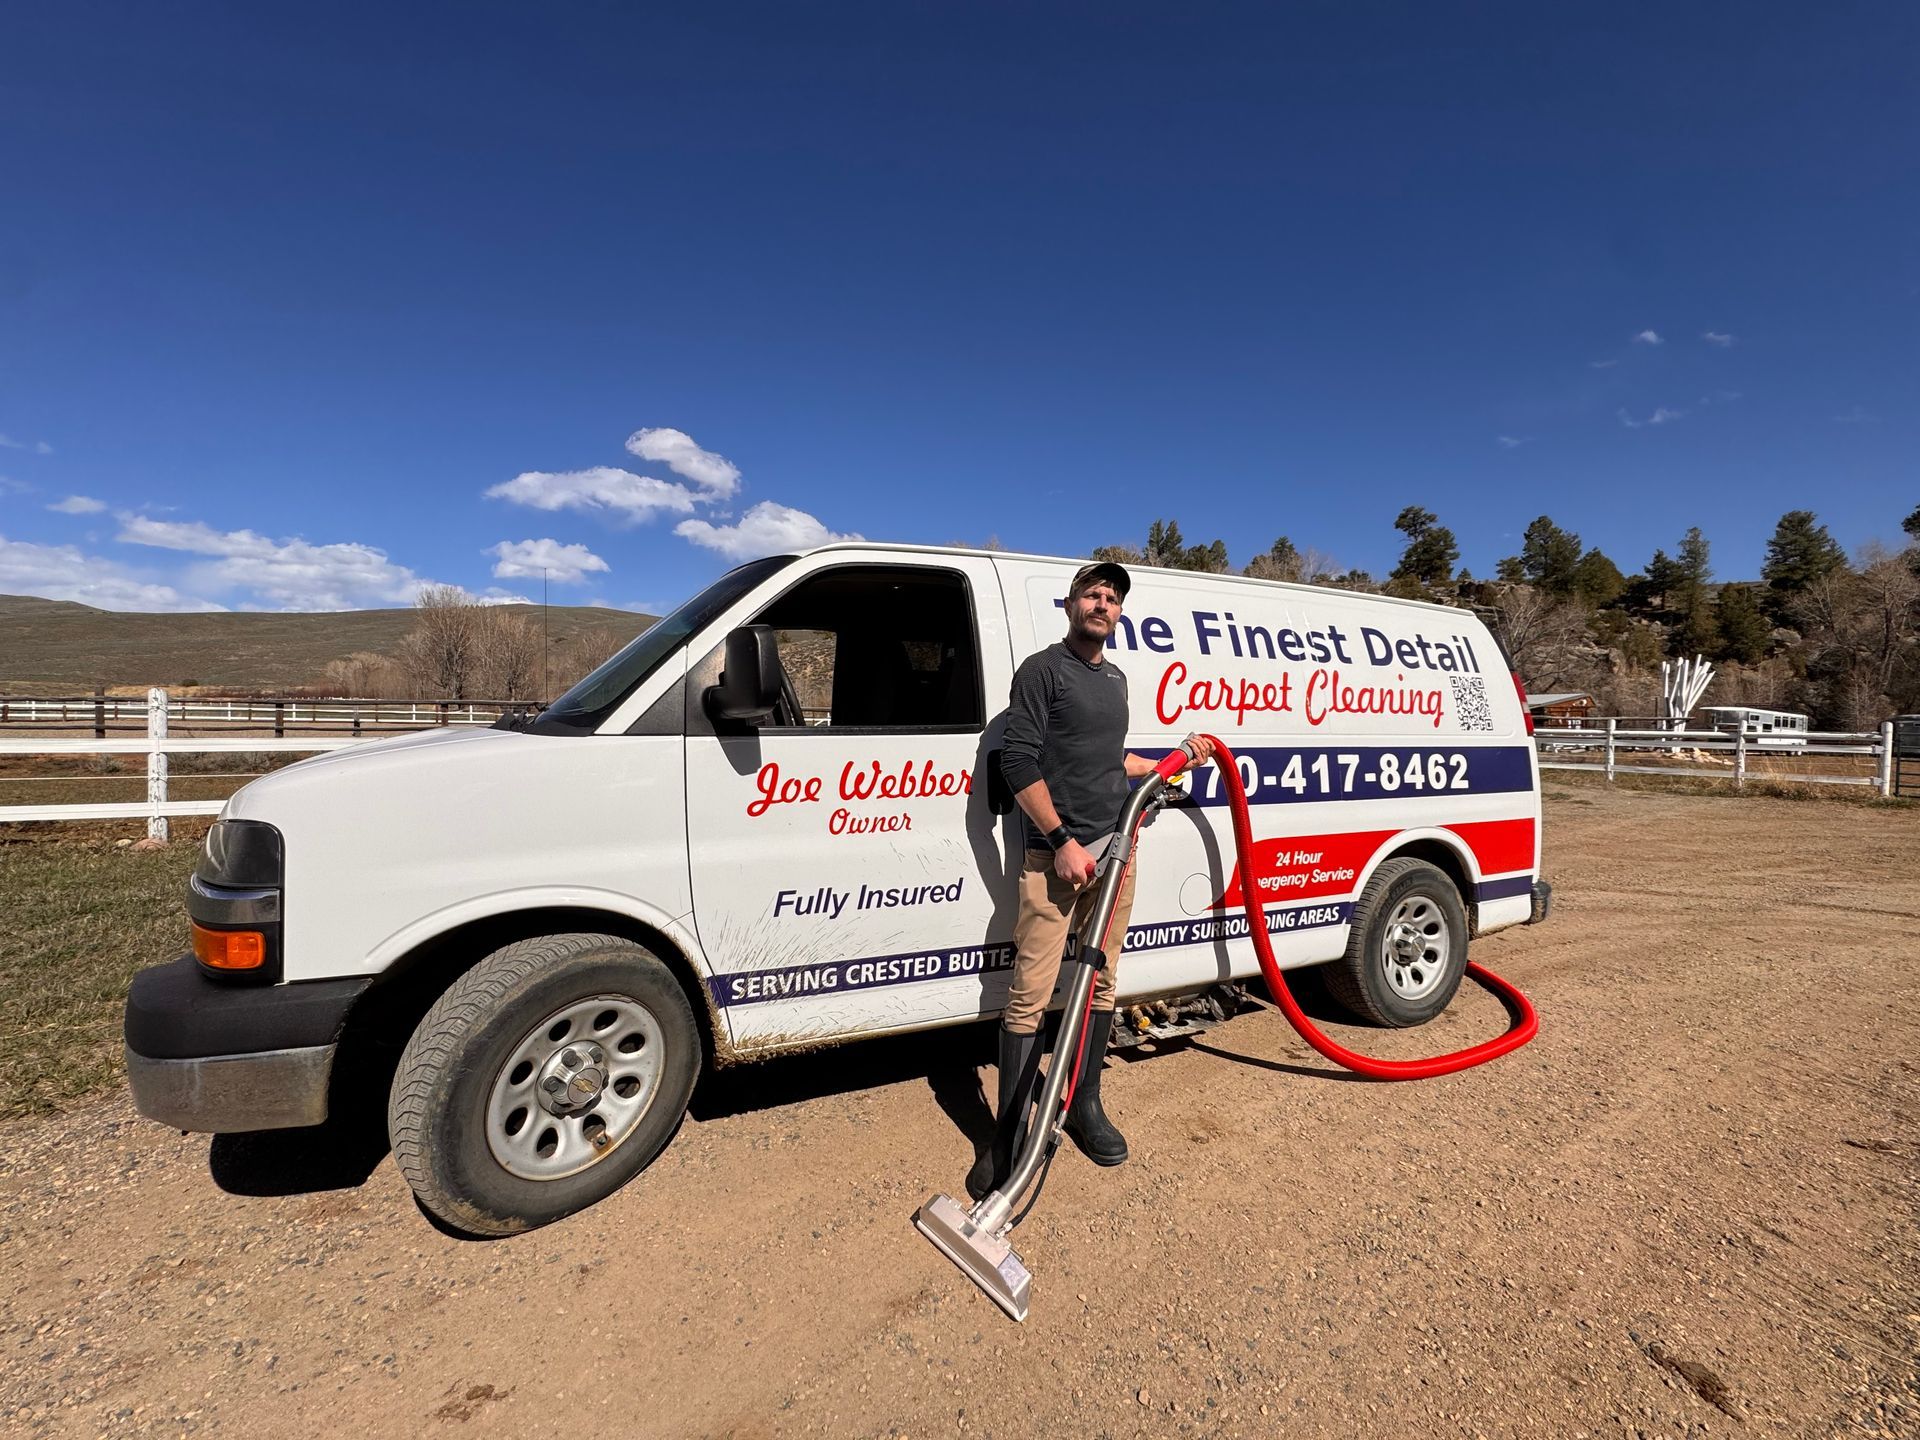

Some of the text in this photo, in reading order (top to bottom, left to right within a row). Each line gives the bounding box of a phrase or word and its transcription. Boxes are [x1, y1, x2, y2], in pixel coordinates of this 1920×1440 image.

[1053, 598, 1480, 673] he Finest Detail
[1155, 661, 1444, 728] Carpet Cleaning
[747, 760, 973, 817] Joe Webber
[829, 808, 912, 835] Owner
[1275, 850, 1324, 867] 24 Hour
[1311, 867, 1355, 884] Service
[773, 878, 964, 919] Fully Insured
[731, 967, 838, 1001] SERVING
[845, 955, 942, 984] CRESTED
[1123, 927, 1188, 950] COUNTY
[1191, 912, 1296, 940] SURROUDING
[1298, 906, 1340, 926] AREAS
